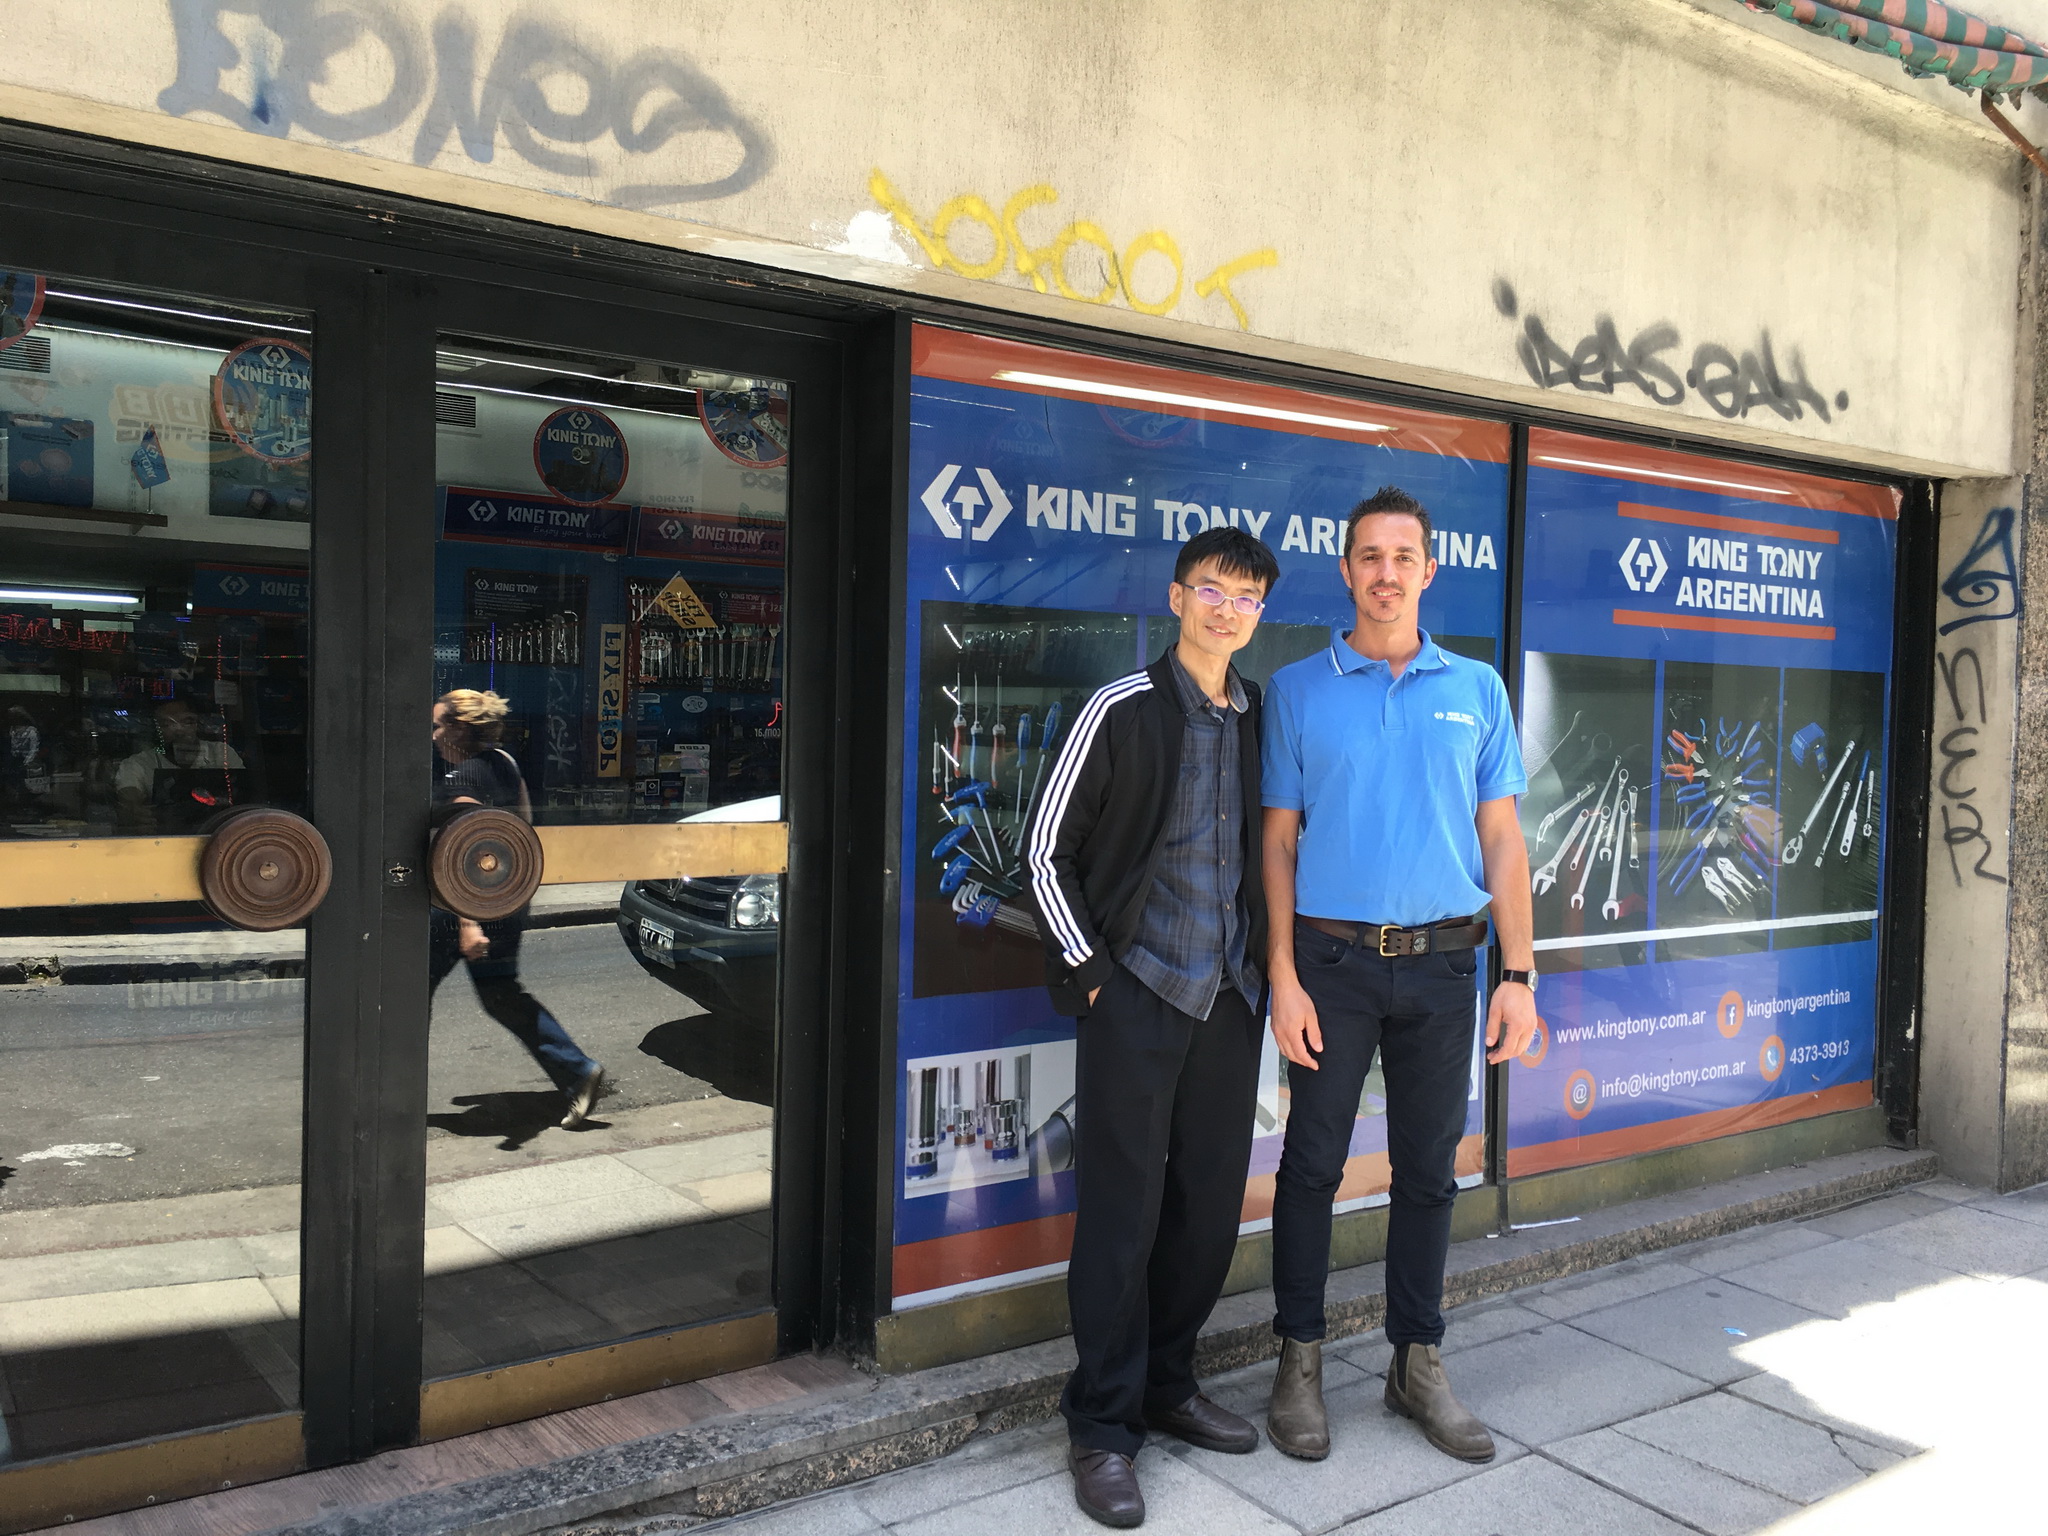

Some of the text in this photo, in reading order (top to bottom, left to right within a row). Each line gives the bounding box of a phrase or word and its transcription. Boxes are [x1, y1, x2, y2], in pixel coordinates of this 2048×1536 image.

[233, 363, 274, 385] KING
[547, 428, 617, 449] KING TONY
[507, 506, 590, 529] KING TONY
[1026, 484, 1138, 538] KING
[1281, 514, 1497, 570] ARINA
[532, 525, 559, 538] Enjoy
[692, 524, 766, 545] KING TONY
[1687, 536, 1822, 580] KING TONY
[261, 580, 301, 597] KING
[494, 581, 538, 595] KING TONY
[1675, 576, 1824, 619] ARGENTINA
[1747, 988, 1851, 1018] kingtonyargentina
[1556, 1009, 1706, 1044] www.kingtony.com.ar
[1789, 1040, 1850, 1065] 4373-3913
[1601, 1059, 1746, 1098] info@kingtony.com.ar
